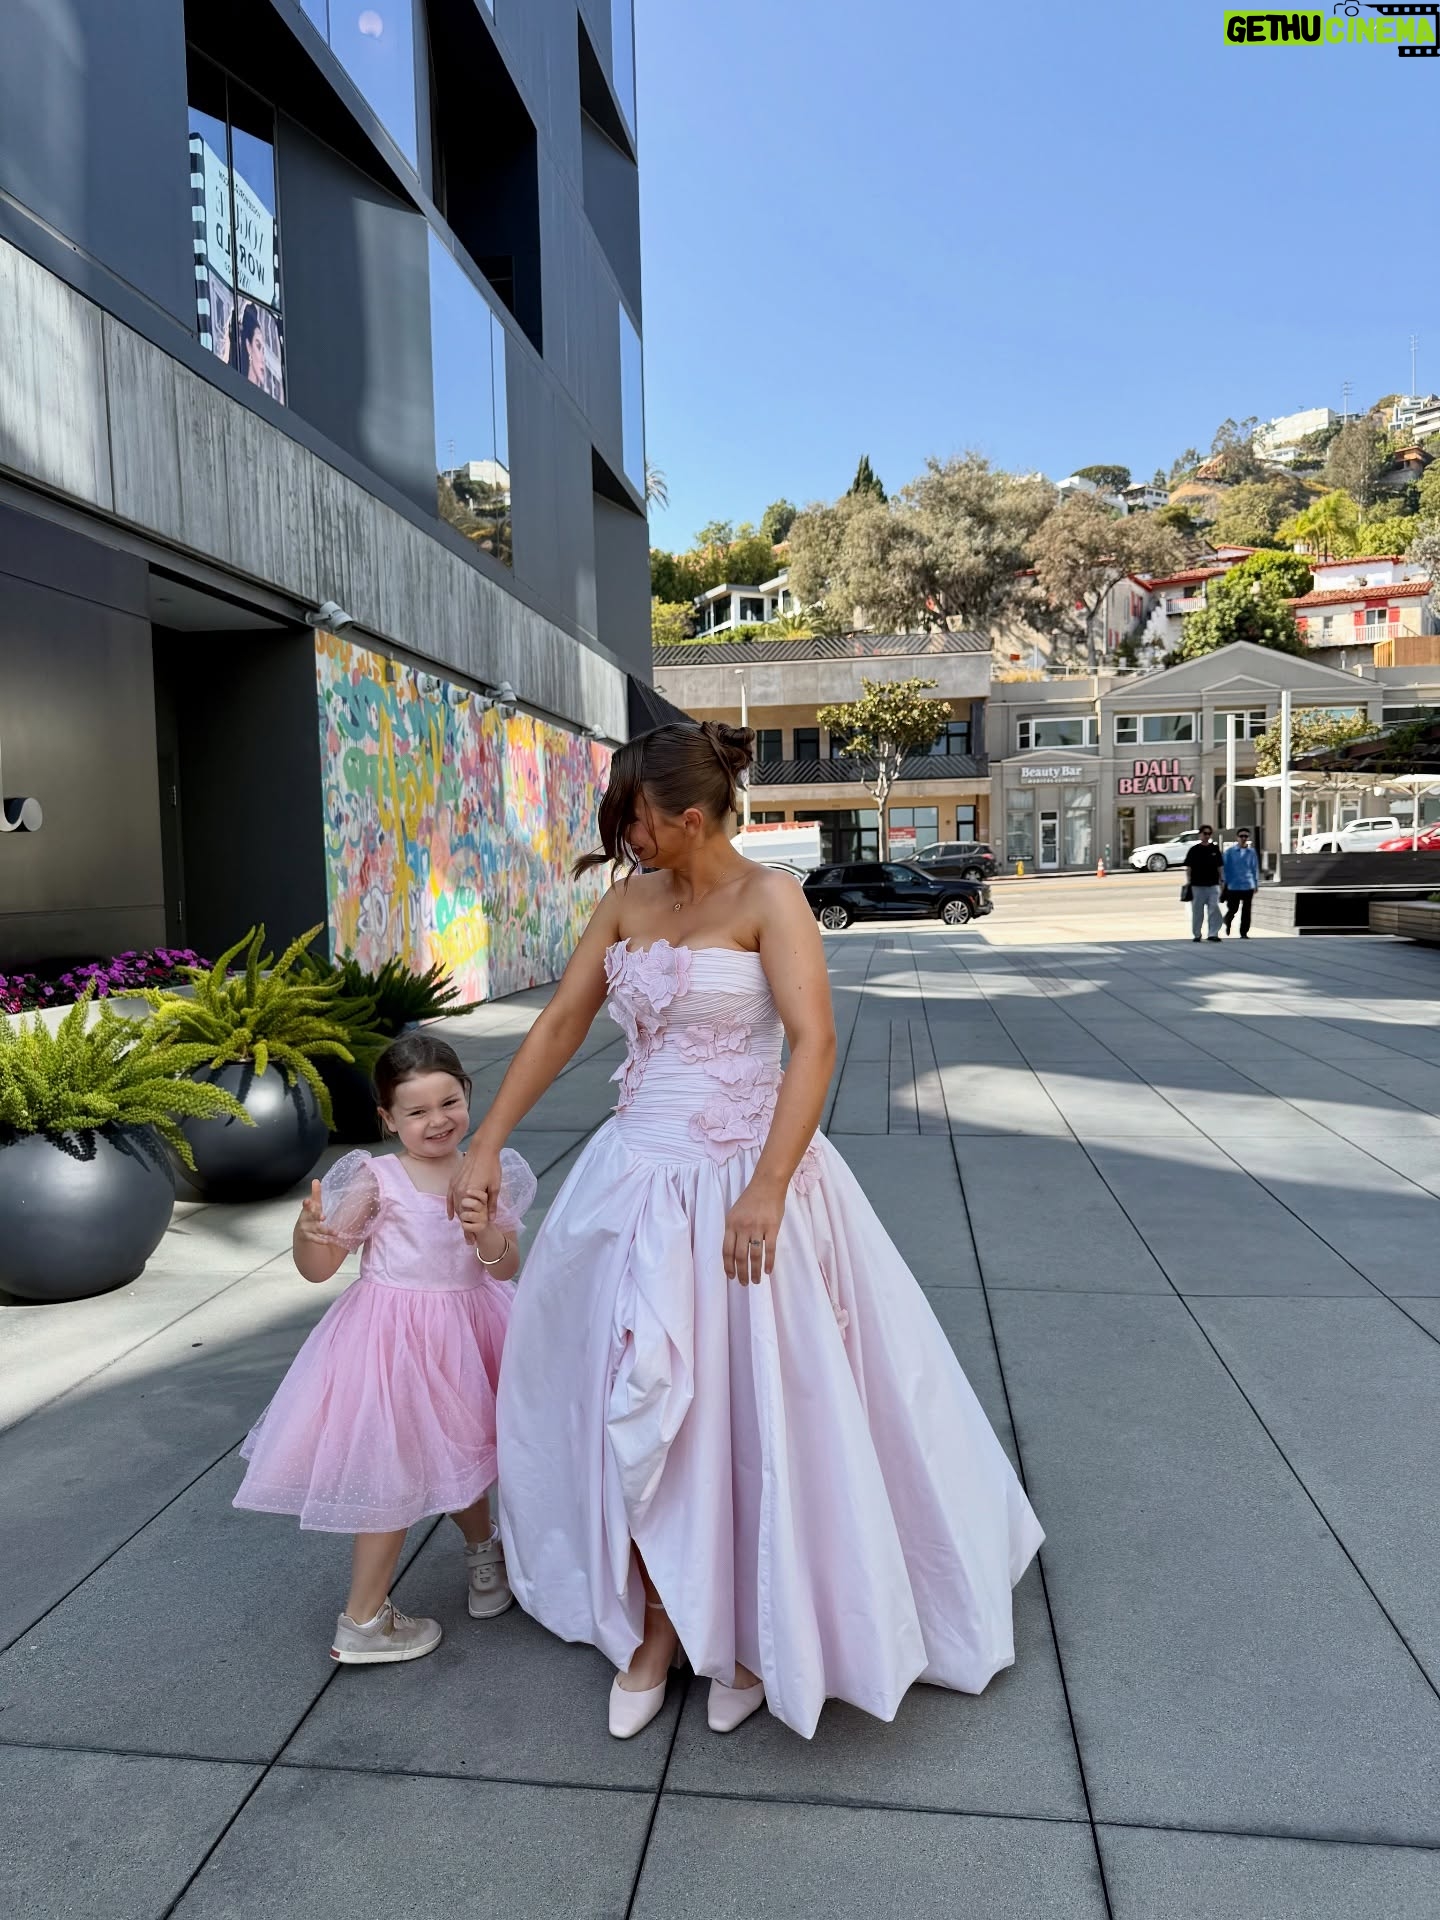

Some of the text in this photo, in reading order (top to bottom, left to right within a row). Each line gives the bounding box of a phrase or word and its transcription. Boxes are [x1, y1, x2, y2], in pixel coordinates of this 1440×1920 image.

[1021, 766, 1082, 778] Beauty Bar
[1134, 759, 1179, 777] DALI
[1119, 775, 1195, 794] BEAUTY
